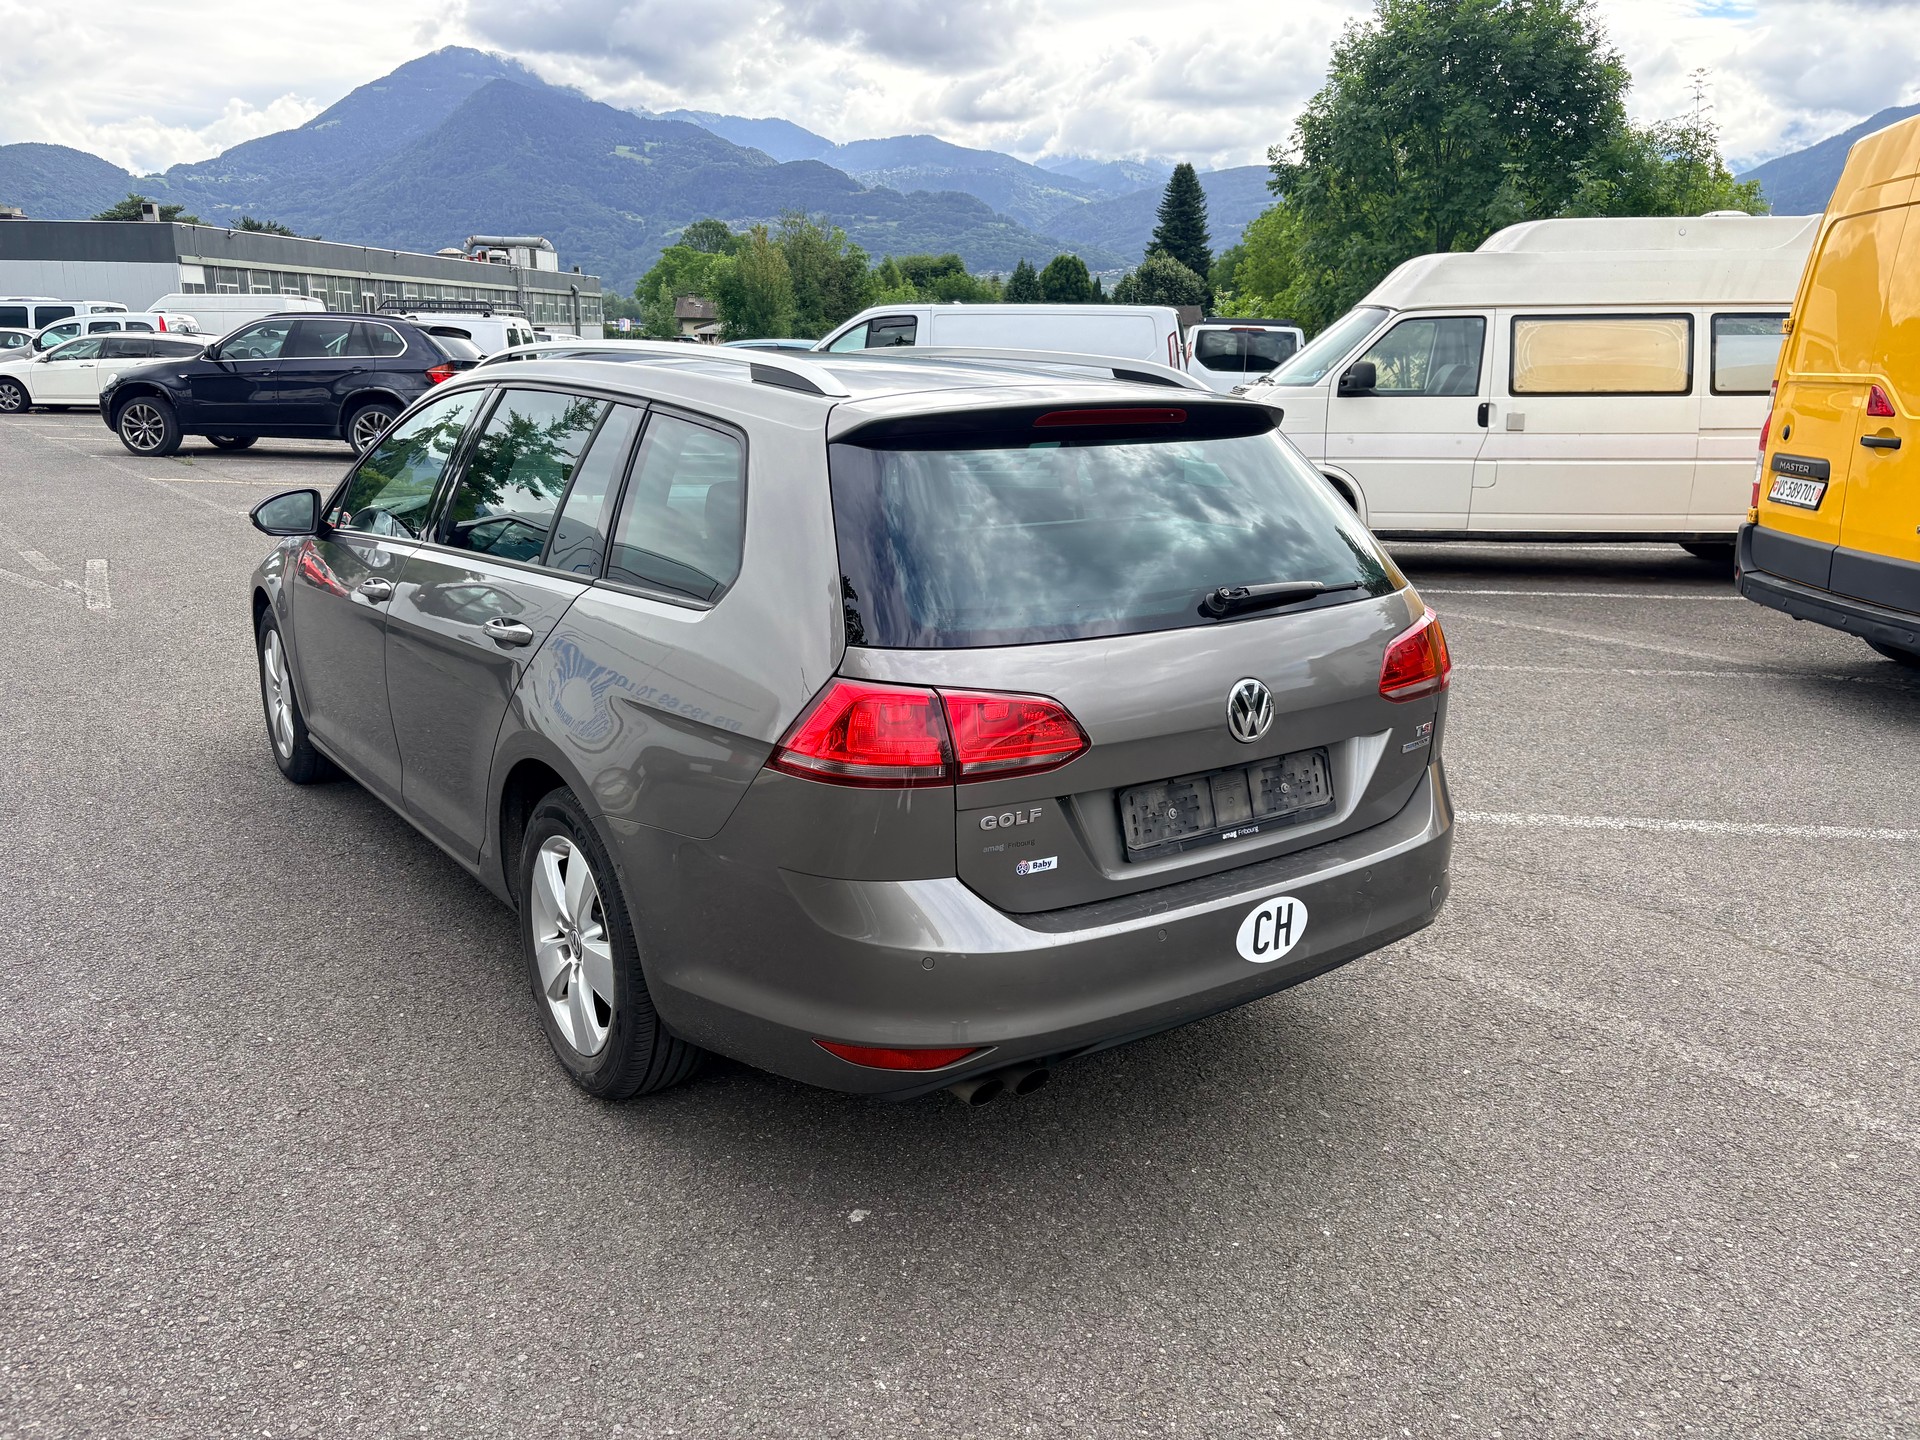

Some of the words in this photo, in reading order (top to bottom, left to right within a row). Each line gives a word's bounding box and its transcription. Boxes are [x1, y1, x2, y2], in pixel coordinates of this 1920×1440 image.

[1779, 461, 1810, 474] MASTER
[979, 808, 1043, 831] GOLF
[1222, 830, 1237, 840] amag
[1238, 825, 1259, 836] Fribourg
[983, 843, 1005, 853] amag
[1007, 839, 1036, 849] Fribourg
[1032, 859, 1052, 870] Baby
[1252, 902, 1294, 955] CH
